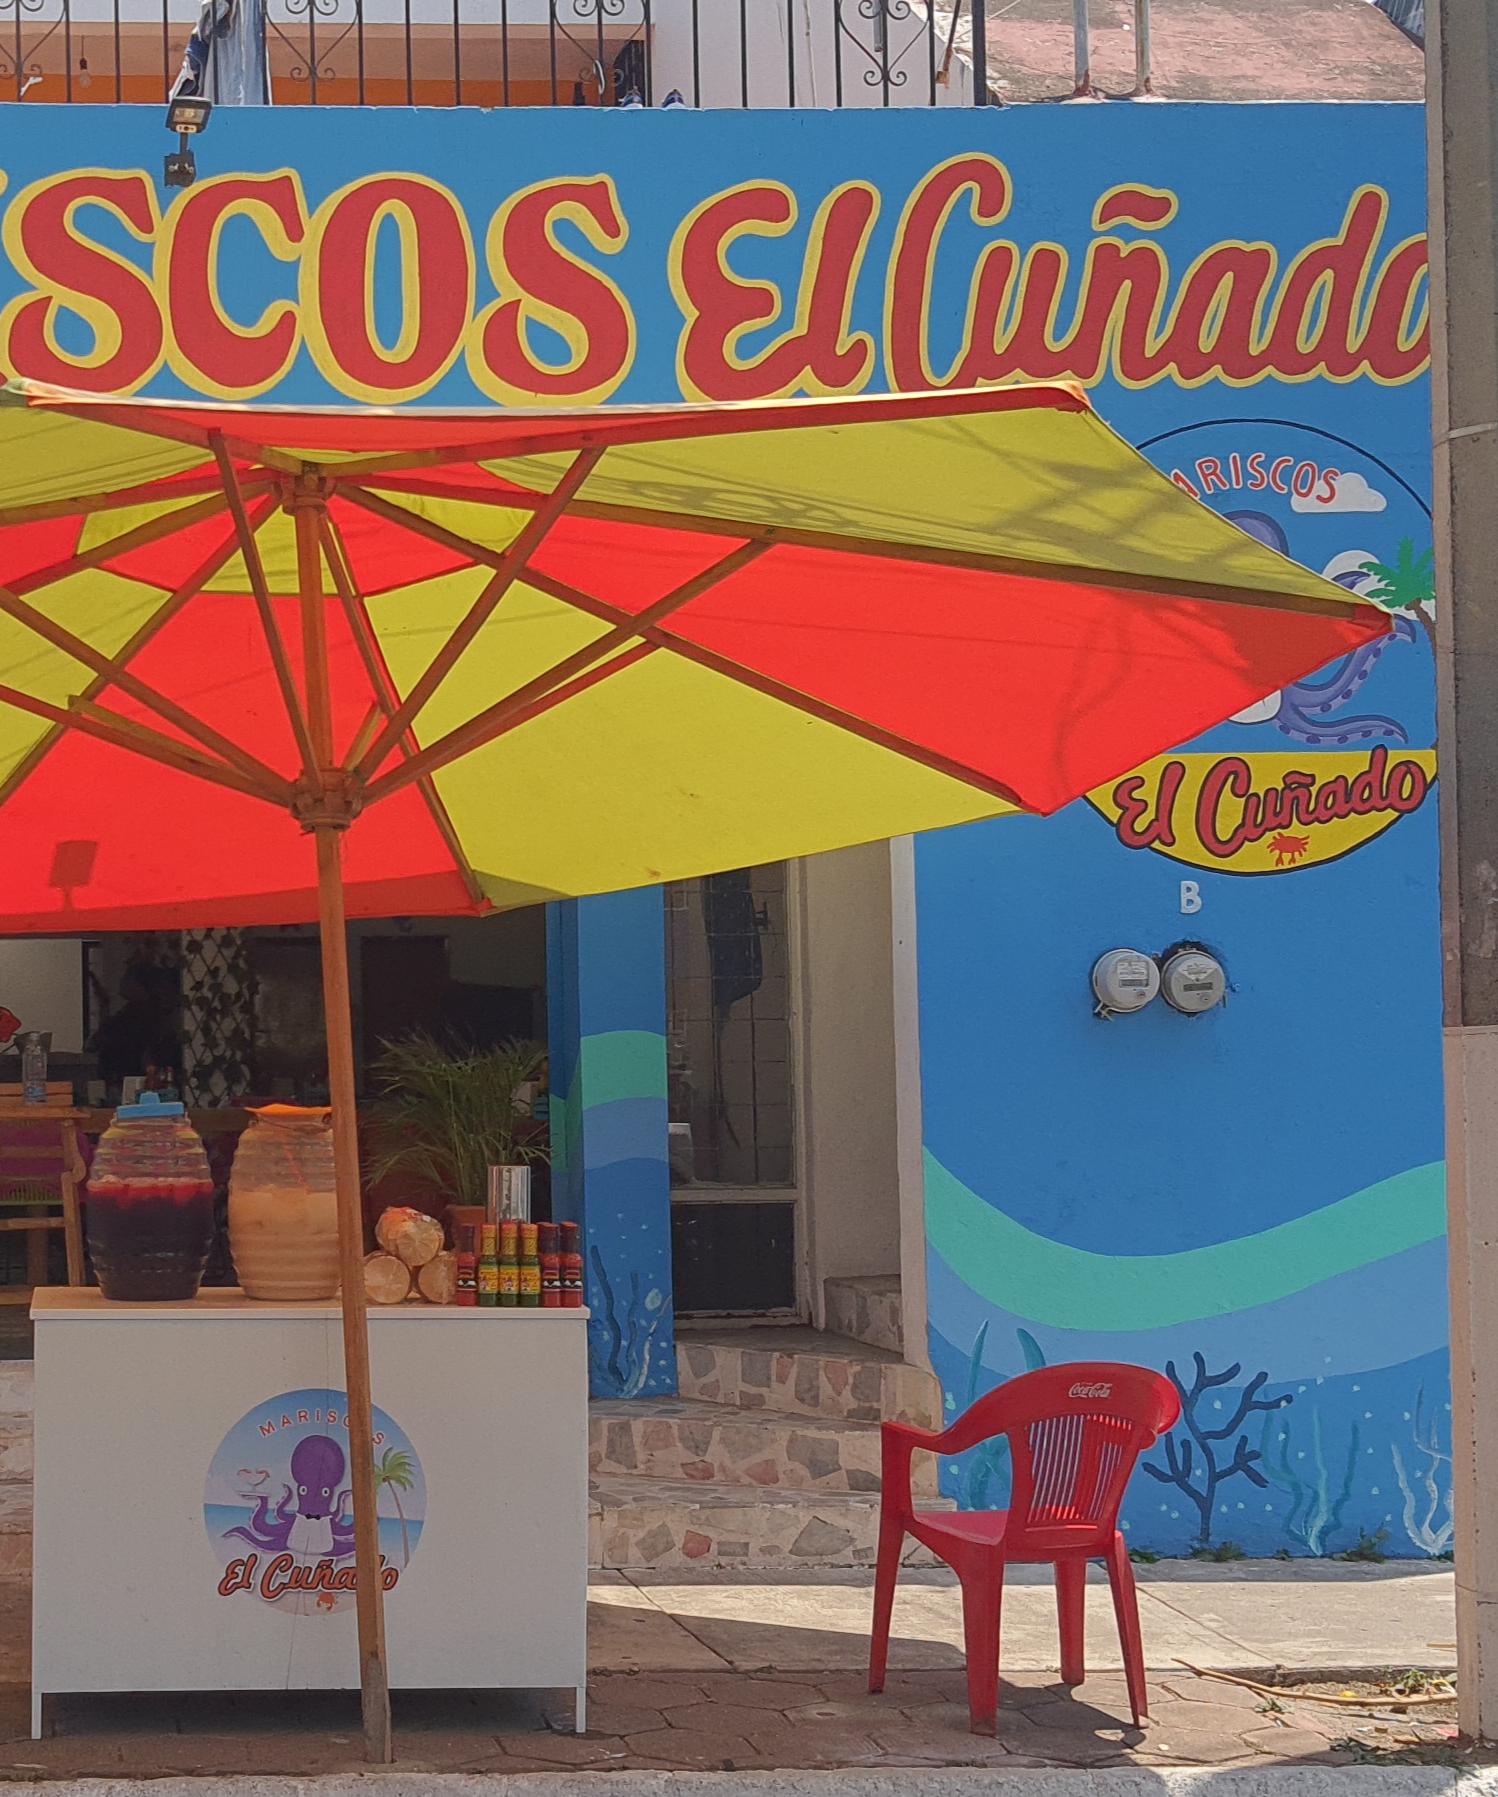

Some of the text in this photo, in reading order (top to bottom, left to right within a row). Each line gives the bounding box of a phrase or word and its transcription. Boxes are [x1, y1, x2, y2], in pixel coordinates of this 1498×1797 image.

[668, 179, 882, 402] El
[883, 151, 1433, 393] Cuñado
[1112, 744, 1427, 858] El Cuñado
[1180, 881, 1203, 914] B
[1068, 1381, 1114, 1399] Coca-Cola
[218, 1553, 399, 1600] El Cuñao
